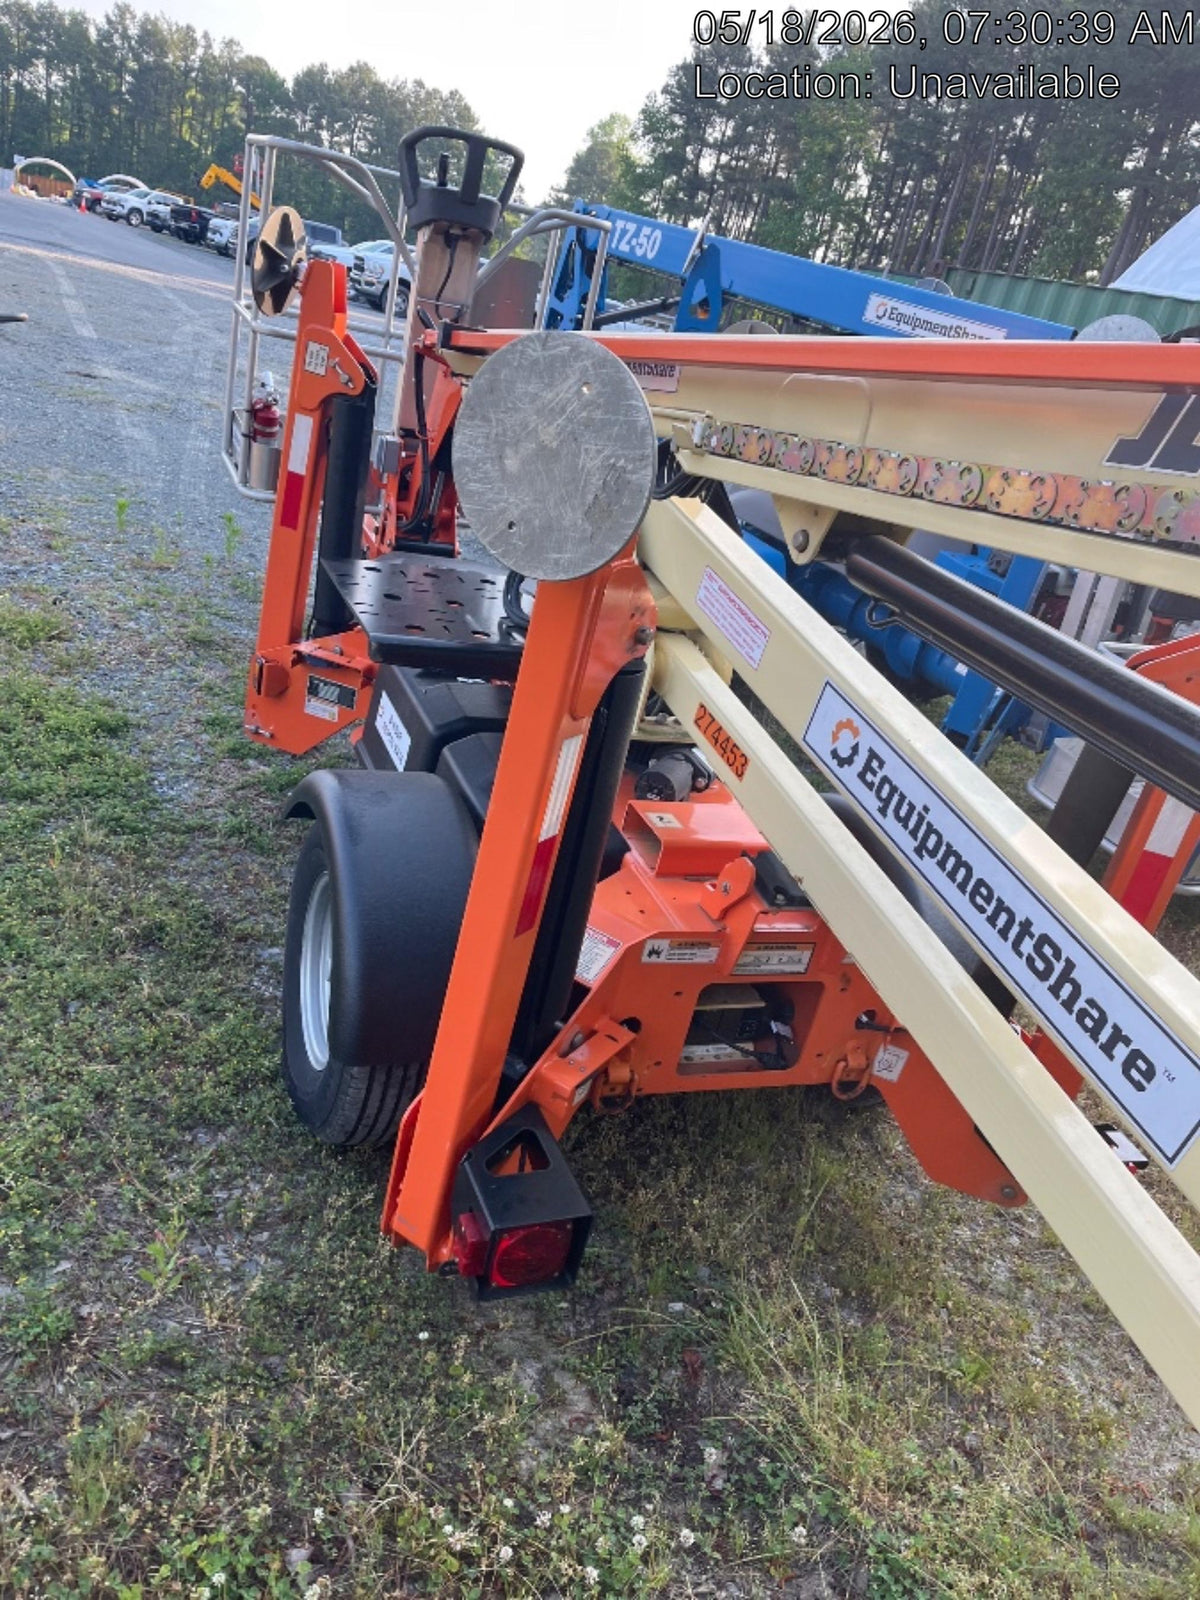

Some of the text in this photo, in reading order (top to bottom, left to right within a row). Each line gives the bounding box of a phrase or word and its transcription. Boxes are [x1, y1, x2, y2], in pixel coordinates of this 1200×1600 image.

[611, 218, 663, 260] TZ-50
[694, 703, 749, 778] 274453
[857, 746, 1157, 1093] EquipmentShare
